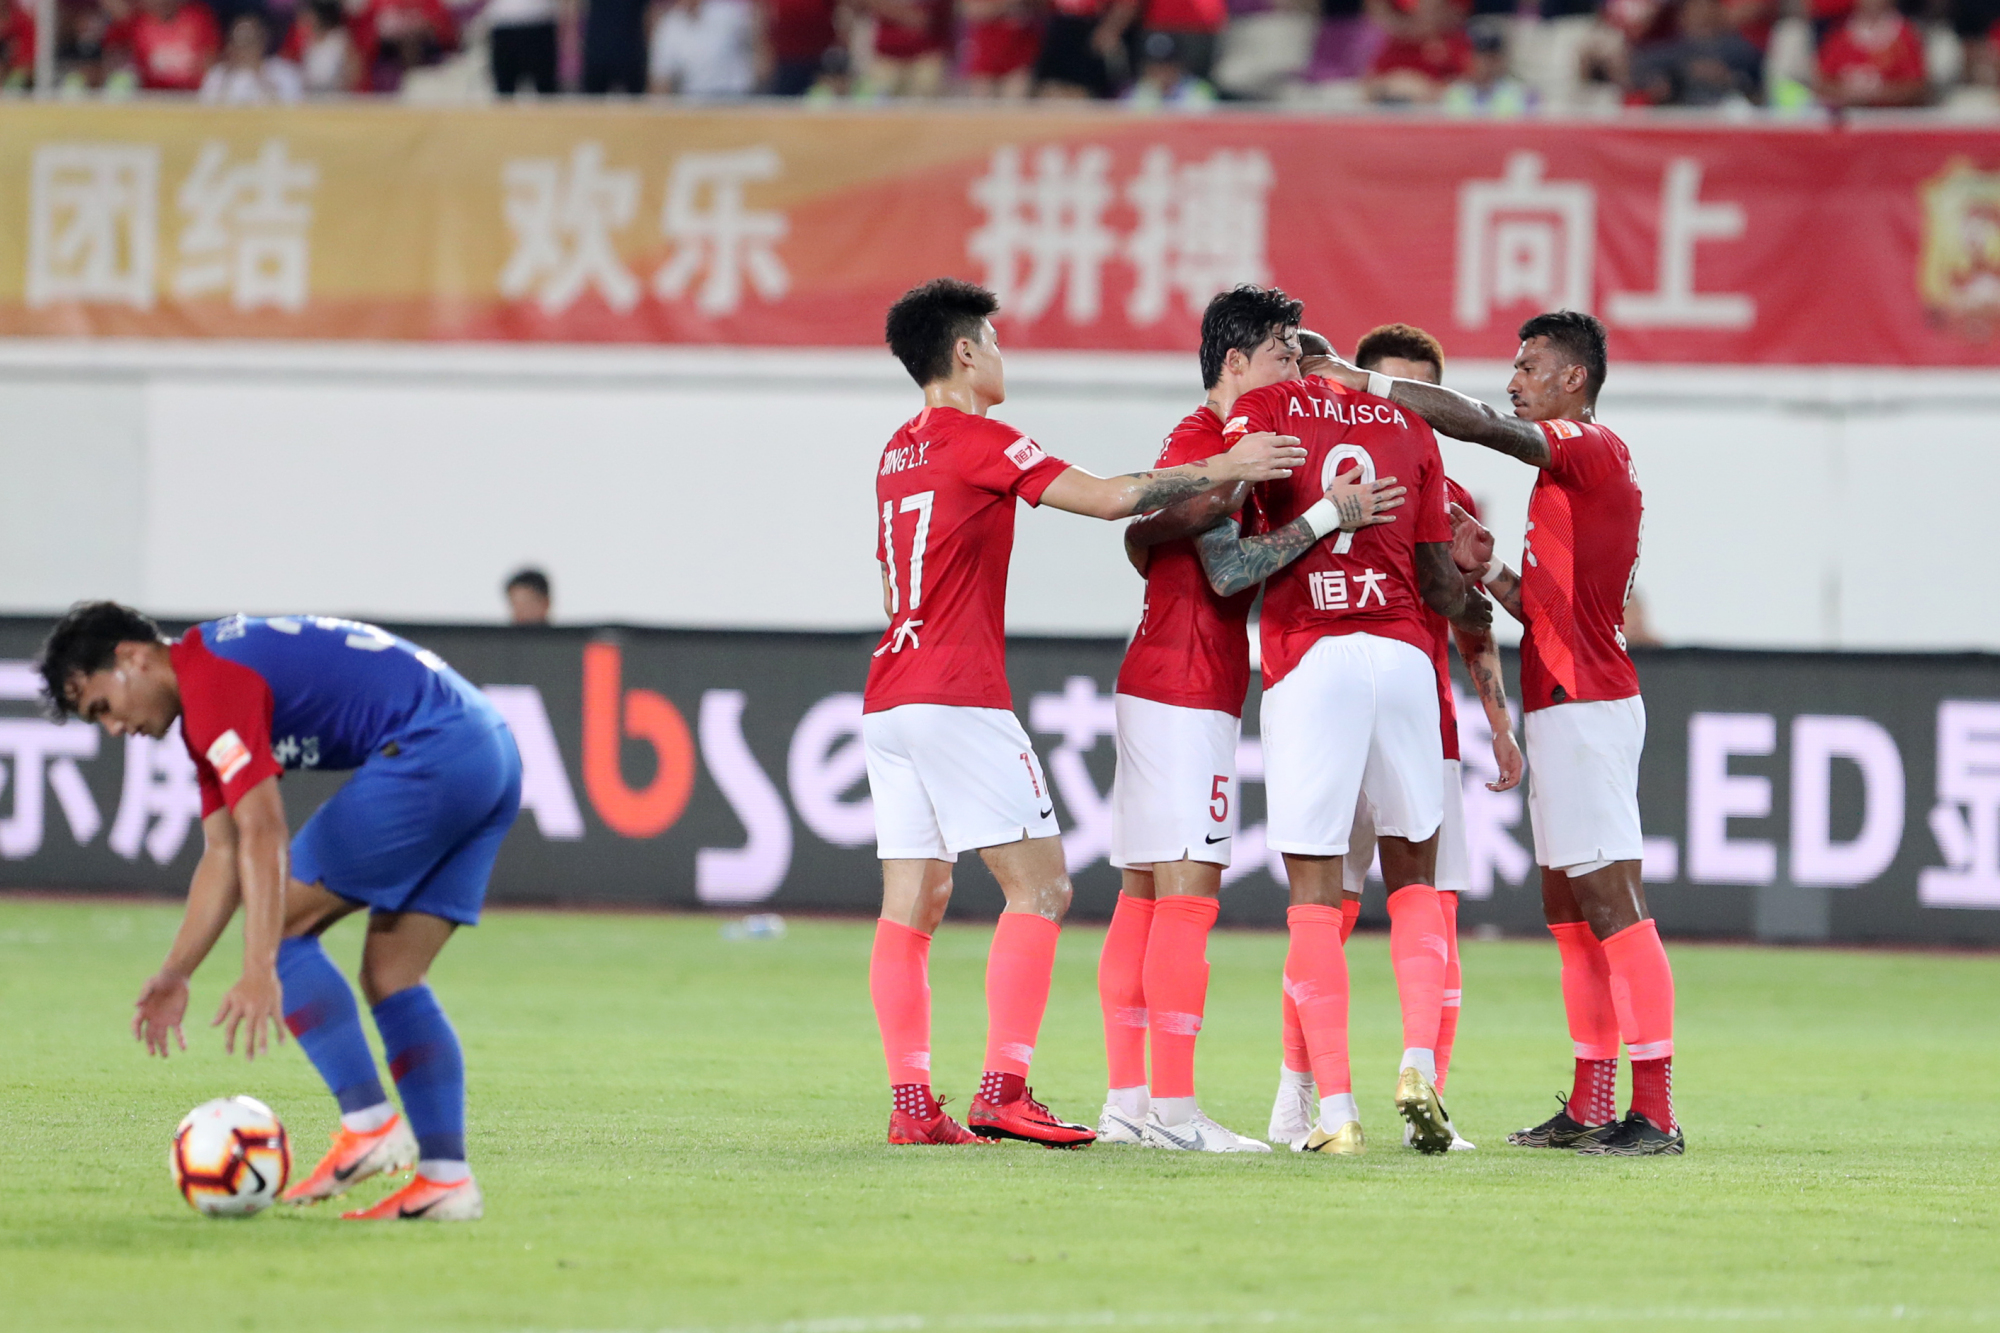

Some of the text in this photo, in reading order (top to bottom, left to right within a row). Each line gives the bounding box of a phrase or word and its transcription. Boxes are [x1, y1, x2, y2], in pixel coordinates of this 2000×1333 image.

[26, 142, 316, 312] 团结
[498, 142, 790, 316] 欢乐
[1454, 150, 1756, 332] 向上
[1288, 396, 1408, 430] A.TALISCA
[882, 490, 935, 614] 17
[1308, 568, 1387, 610] 恒大
[1208, 774, 1230, 823] 5
